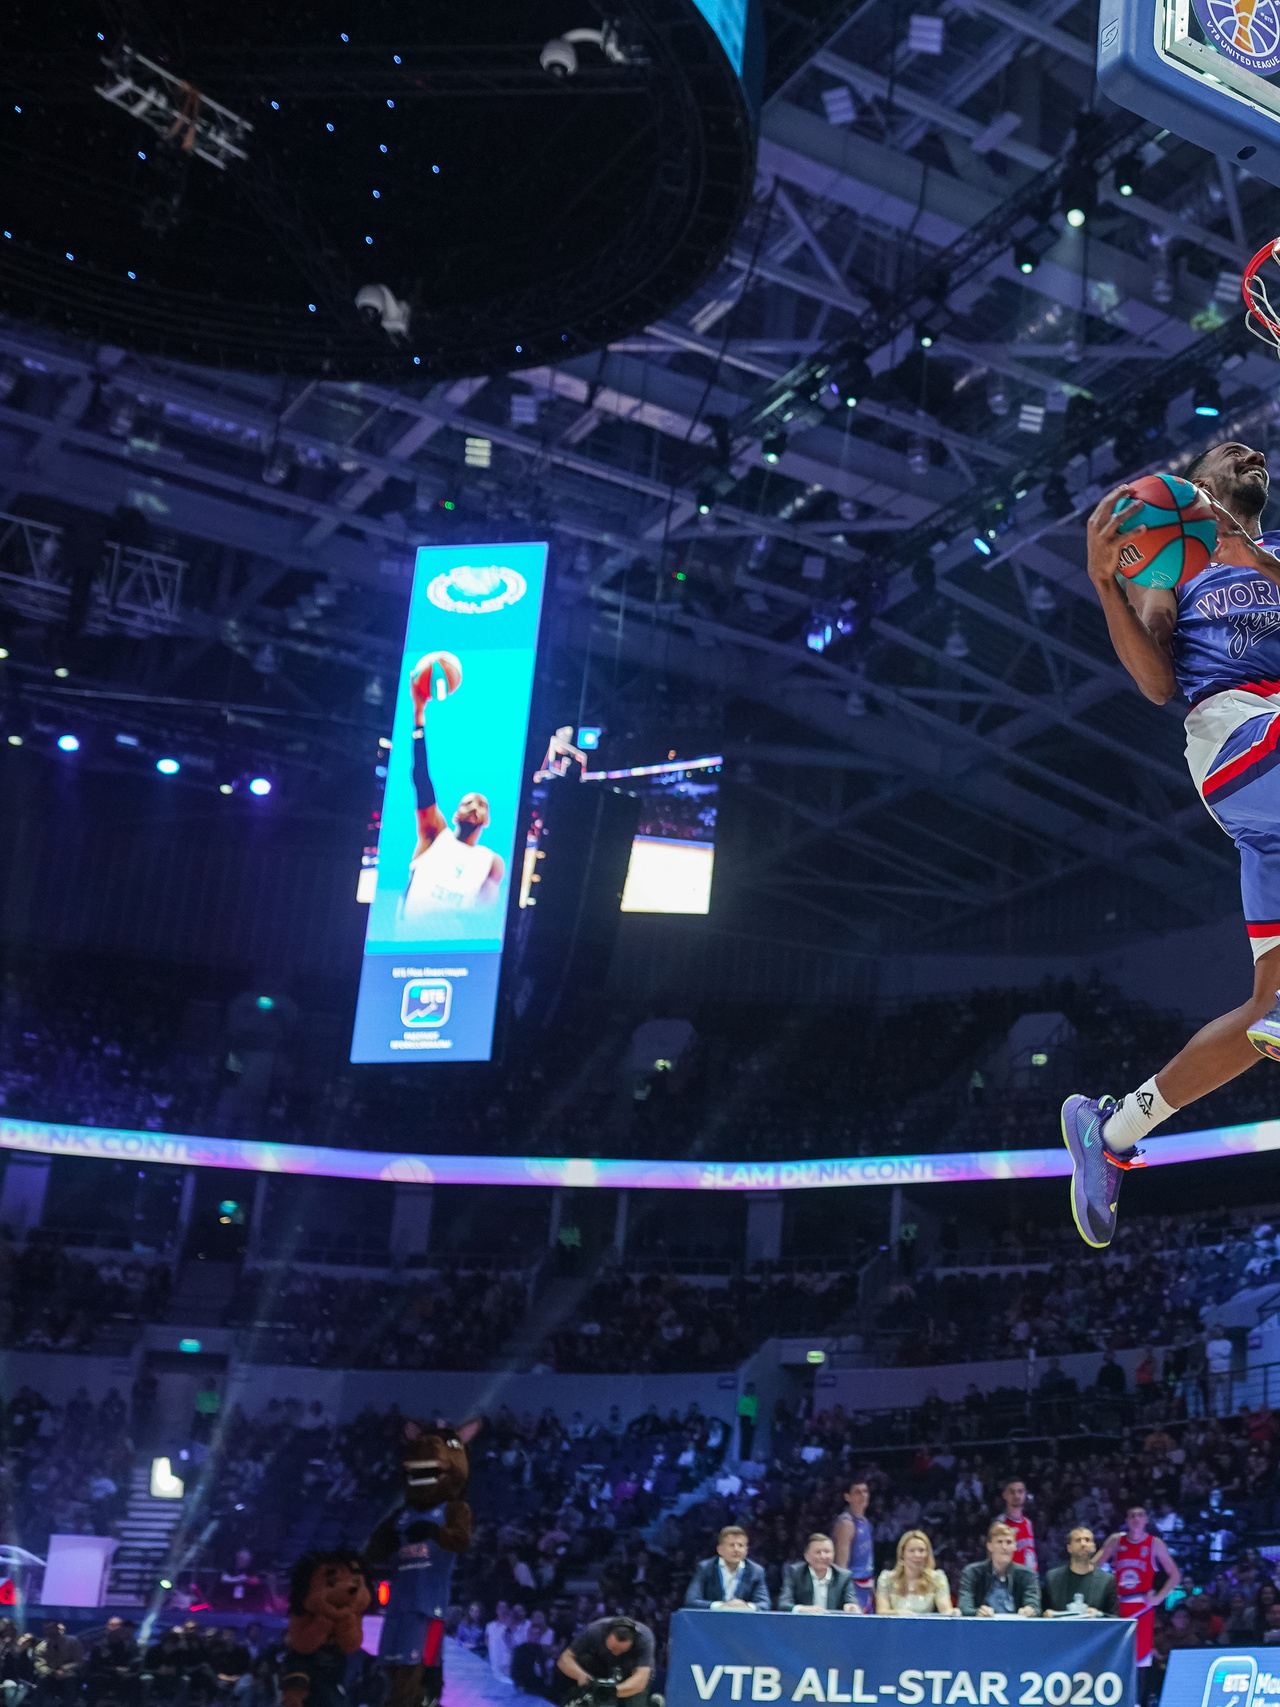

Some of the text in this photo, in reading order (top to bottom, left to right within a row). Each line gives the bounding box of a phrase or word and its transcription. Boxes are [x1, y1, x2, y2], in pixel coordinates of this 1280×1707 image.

[1206, 20, 1280, 69] VTB UNITED LEAGUE
[701, 1164, 774, 1187] SLAM
[780, 1163, 852, 1186] DUNK
[691, 1664, 1124, 1705] VTB ALL-STAR 2020
